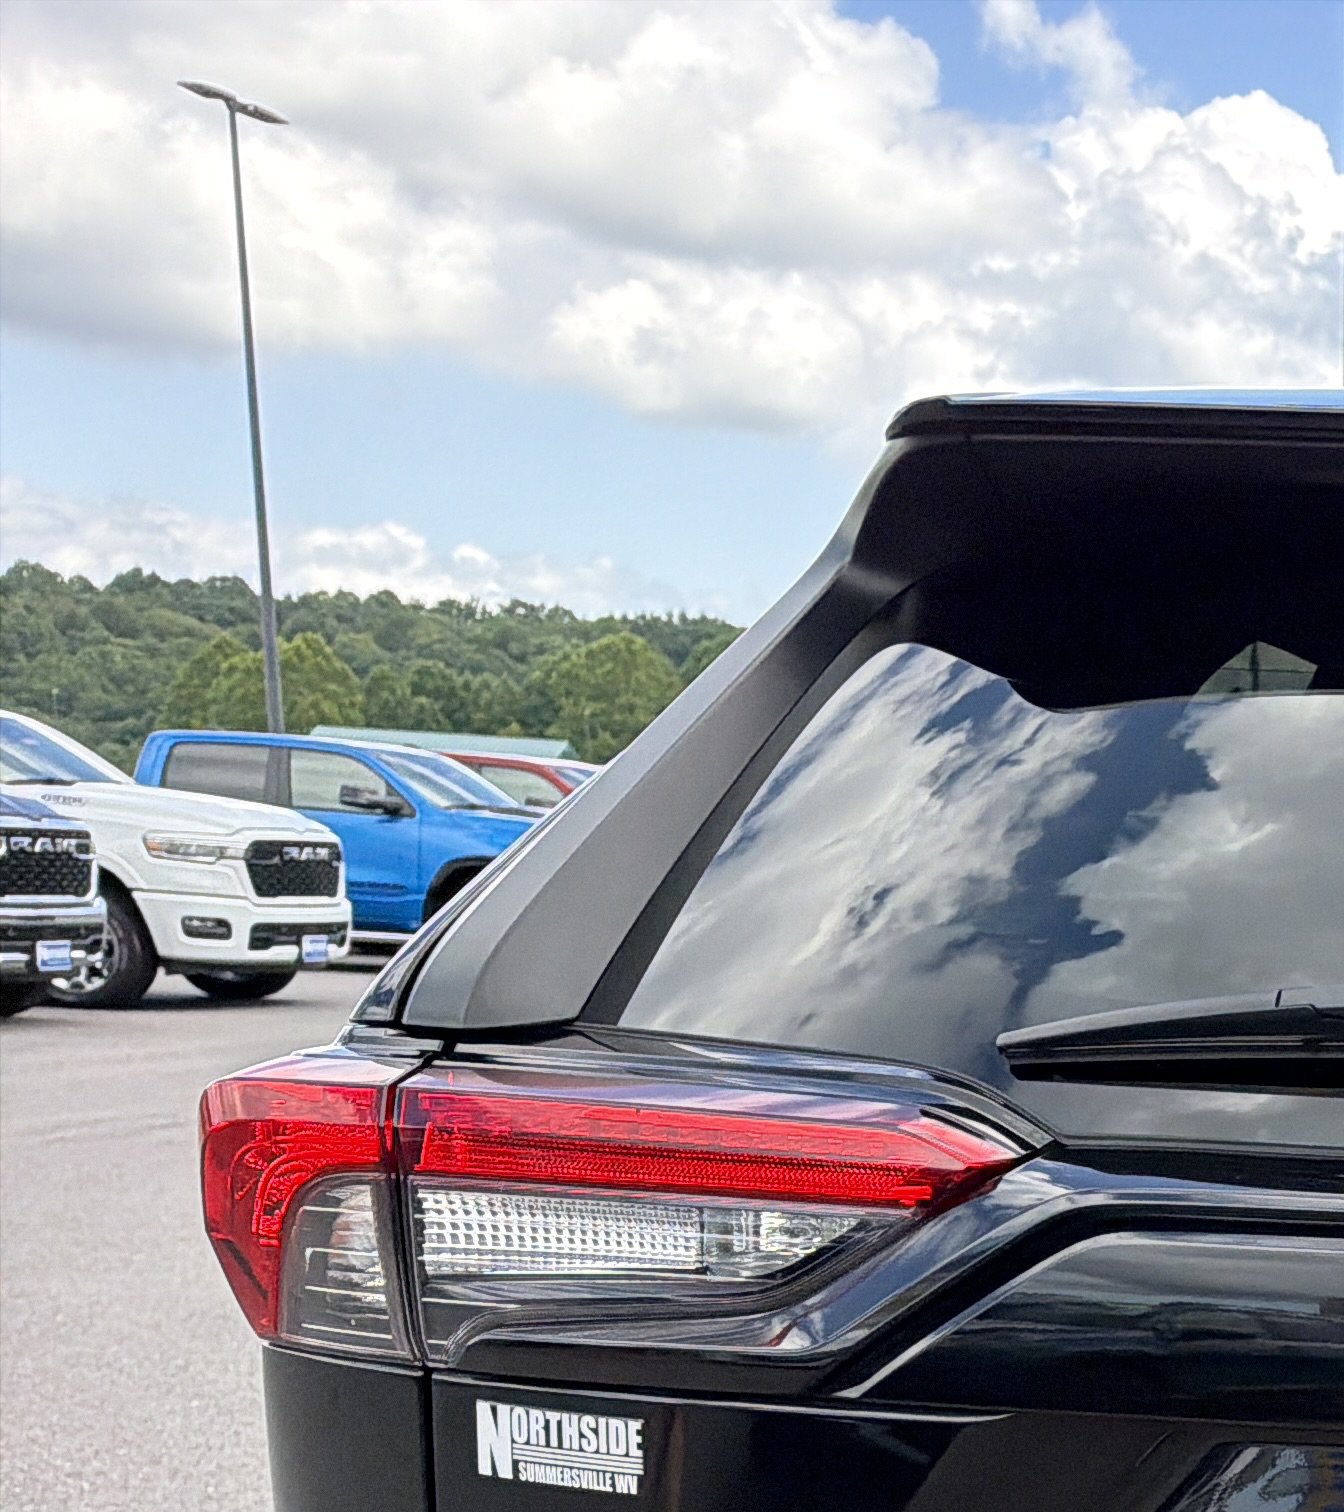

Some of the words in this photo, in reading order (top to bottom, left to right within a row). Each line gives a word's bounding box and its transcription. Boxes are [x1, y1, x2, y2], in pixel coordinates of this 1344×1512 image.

[476, 1399, 645, 1479] NORTHSIDE
[518, 1461, 613, 1493] SUMMERSVILLE
[614, 1473, 639, 1495] WV
